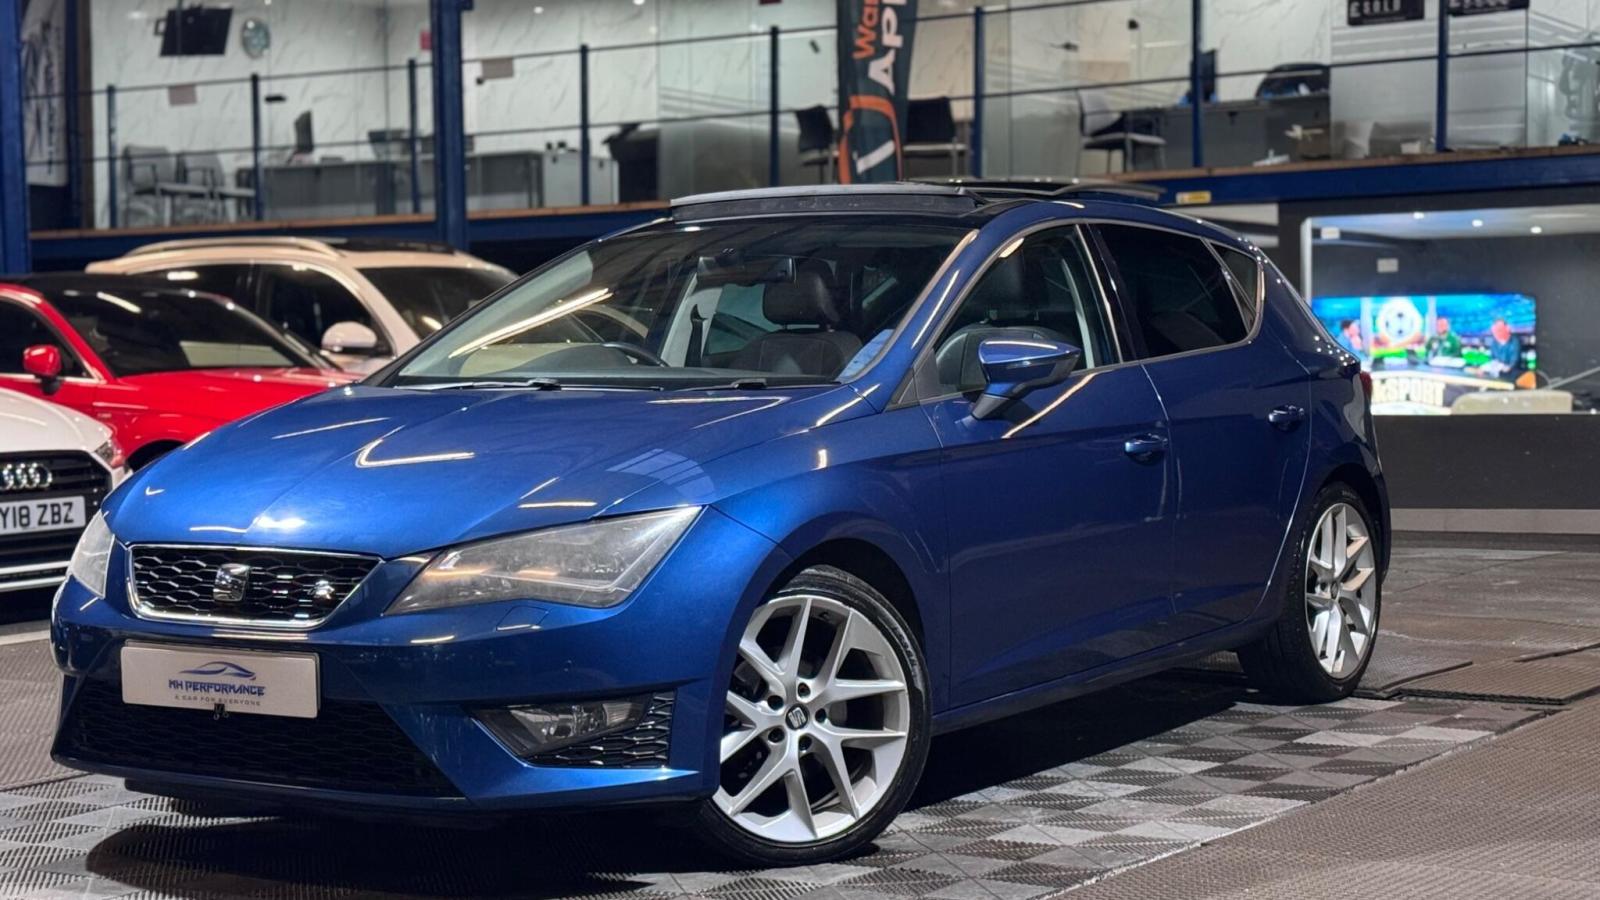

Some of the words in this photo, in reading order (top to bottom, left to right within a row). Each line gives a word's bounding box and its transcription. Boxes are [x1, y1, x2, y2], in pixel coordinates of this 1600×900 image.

[0, 505, 31, 529] Y18
[37, 502, 74, 526] ZBZ
[185, 680, 266, 697] PERFORMANCE
